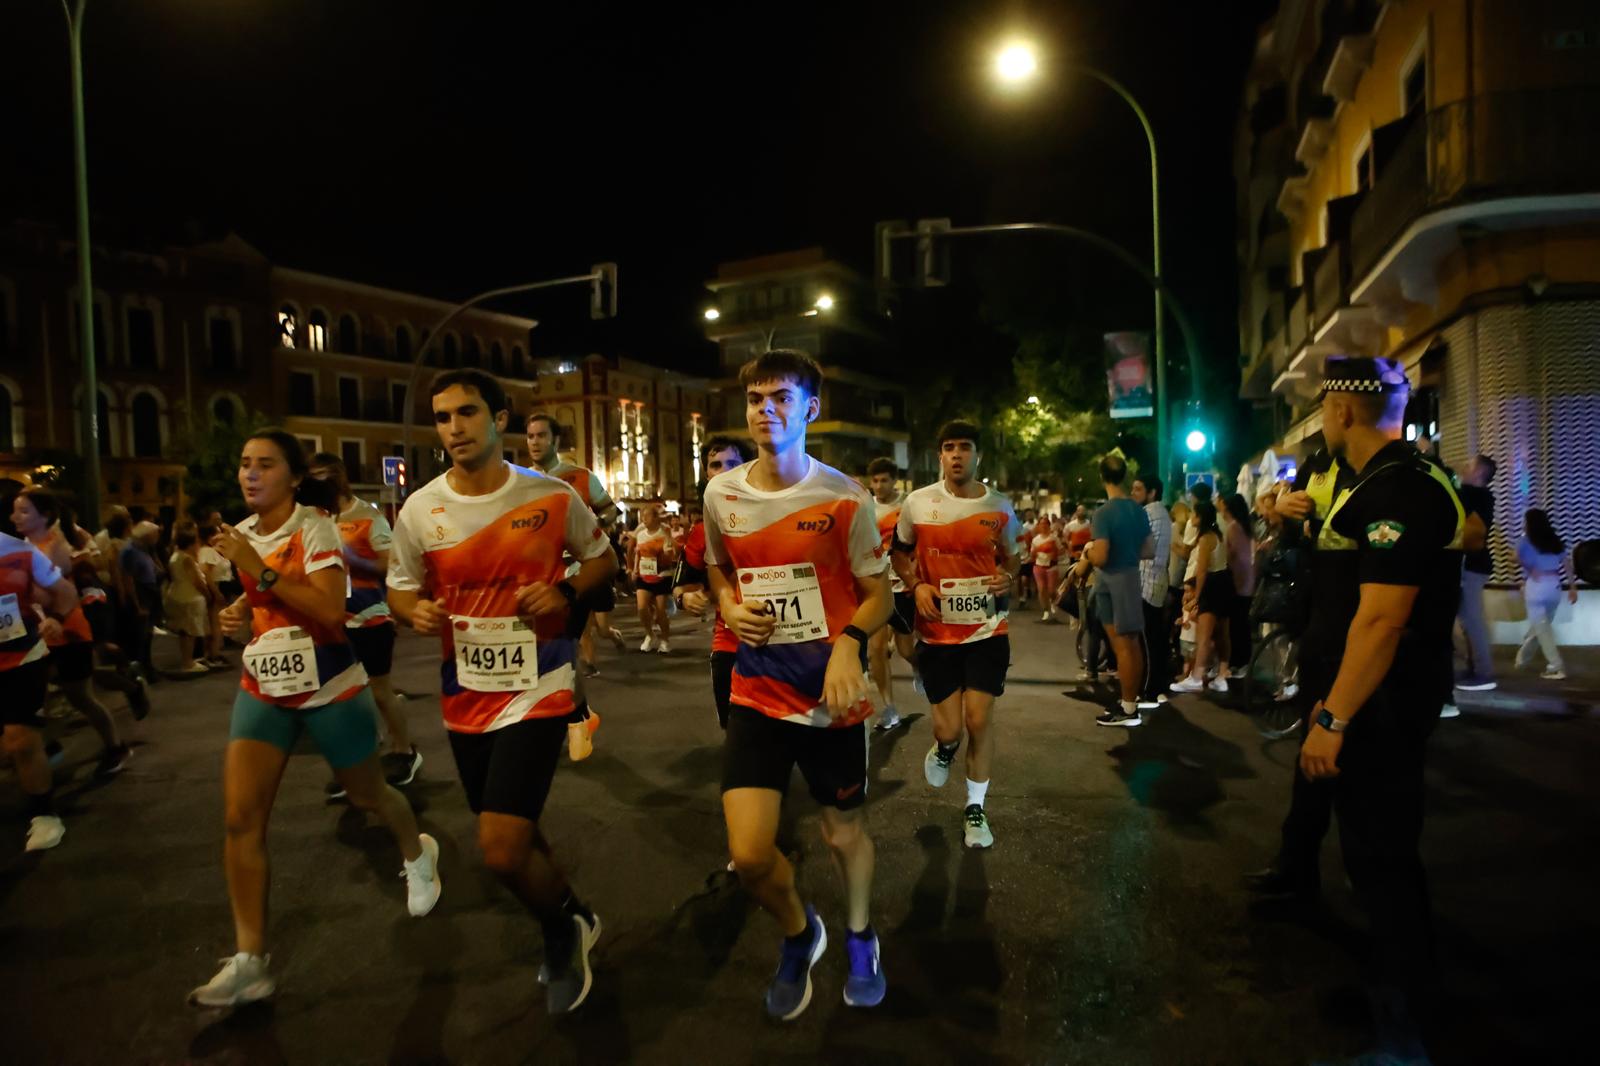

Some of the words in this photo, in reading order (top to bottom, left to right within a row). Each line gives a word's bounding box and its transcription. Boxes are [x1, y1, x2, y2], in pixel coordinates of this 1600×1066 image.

[797, 517, 830, 533] KH7
[948, 595, 988, 612] 18654
[251, 653, 305, 677] 14848
[461, 645, 524, 670] 14914
